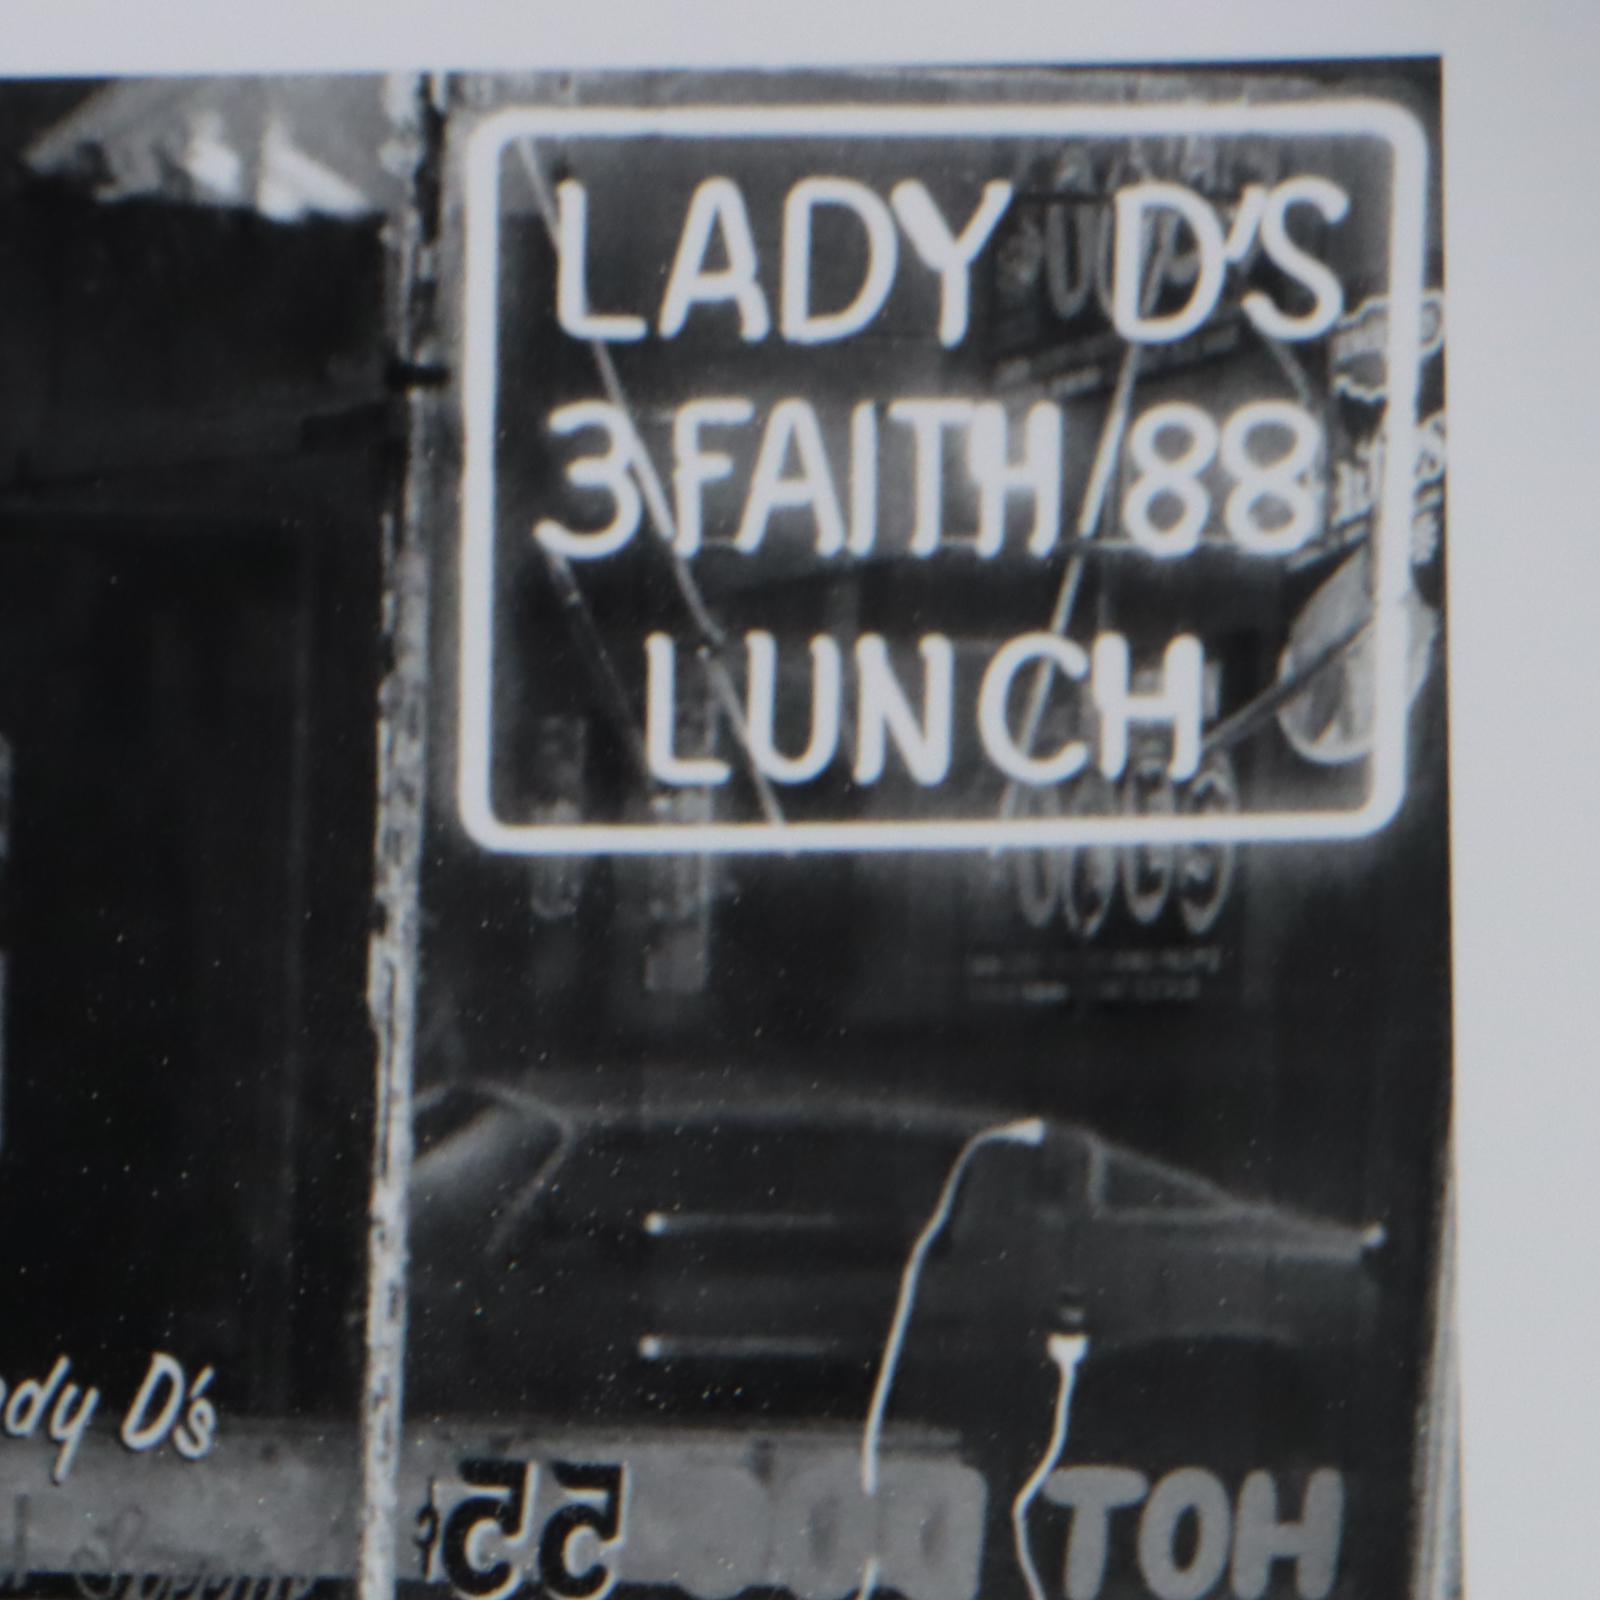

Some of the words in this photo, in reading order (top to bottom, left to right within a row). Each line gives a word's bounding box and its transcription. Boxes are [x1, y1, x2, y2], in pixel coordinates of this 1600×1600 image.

[555, 177, 1013, 347] LADY
[1111, 175, 1350, 345] D'S
[644, 630, 1207, 787] LUNCH
[119, 1350, 218, 1460] D's
